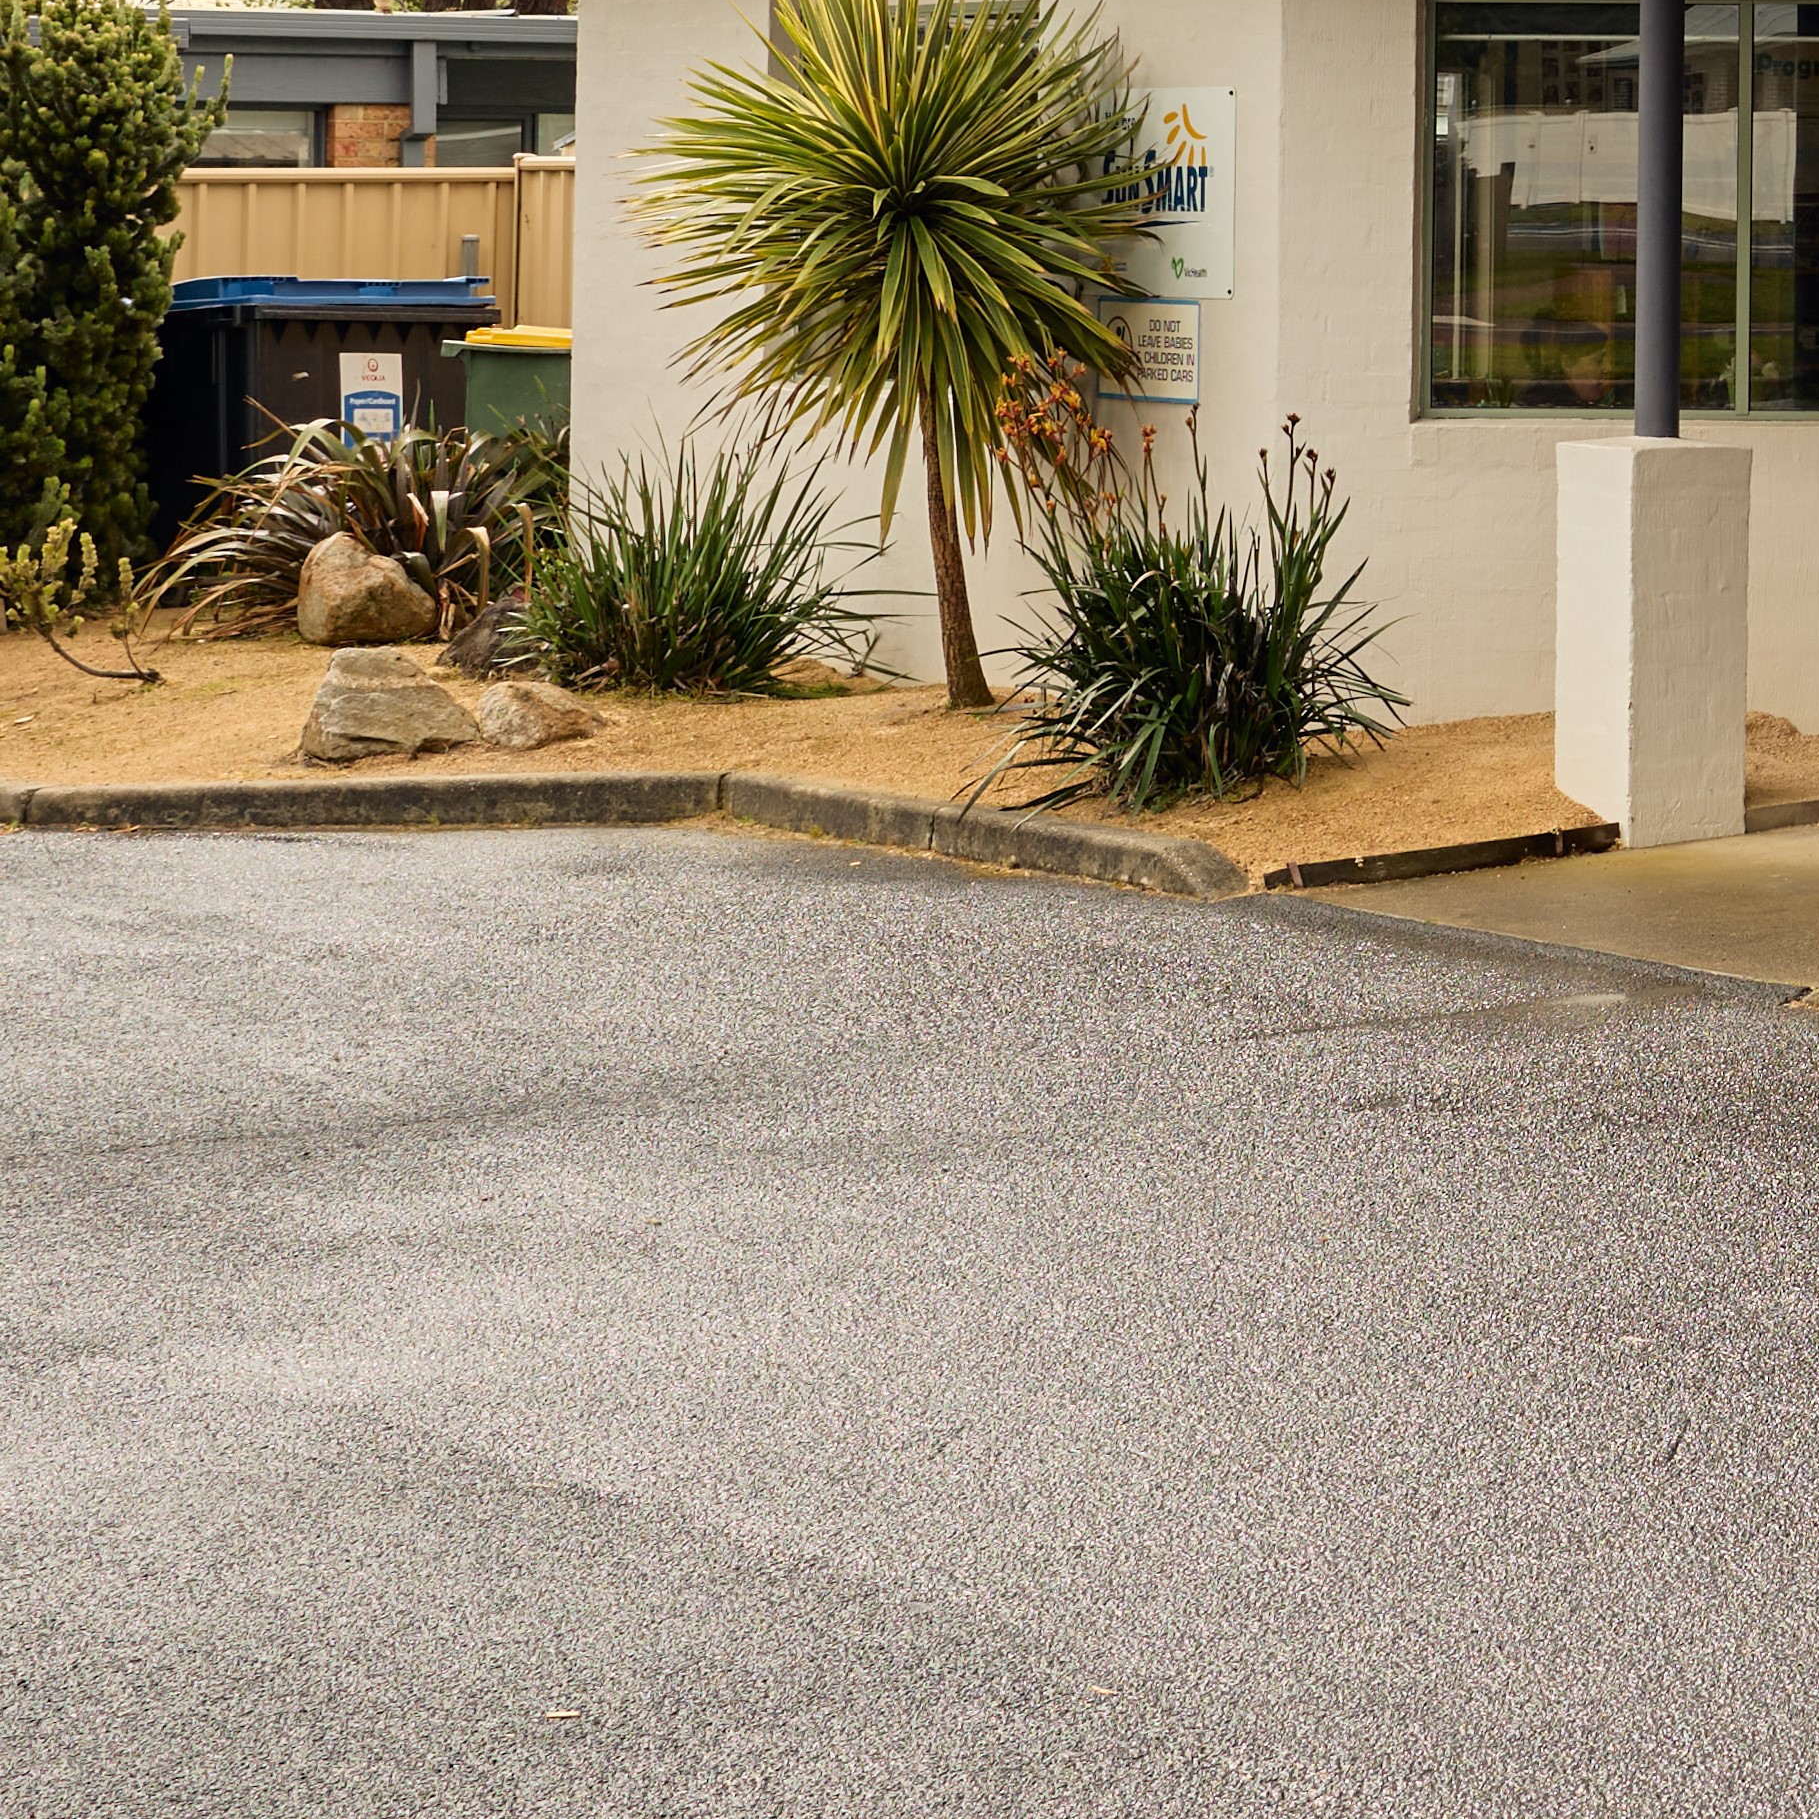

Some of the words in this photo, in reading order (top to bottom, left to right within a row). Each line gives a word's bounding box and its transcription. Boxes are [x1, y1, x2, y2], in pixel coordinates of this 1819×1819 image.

[1150, 319, 1161, 332] DO
[1164, 320, 1181, 333] NOT
[1138, 335, 1161, 348] LEAVE
[1164, 336, 1193, 350] BABIES
[1144, 351, 1184, 366] CHILDREN
[1187, 354, 1195, 366] IN
[1137, 368, 1168, 381] PARKED
[1170, 369, 1194, 382] CARS
